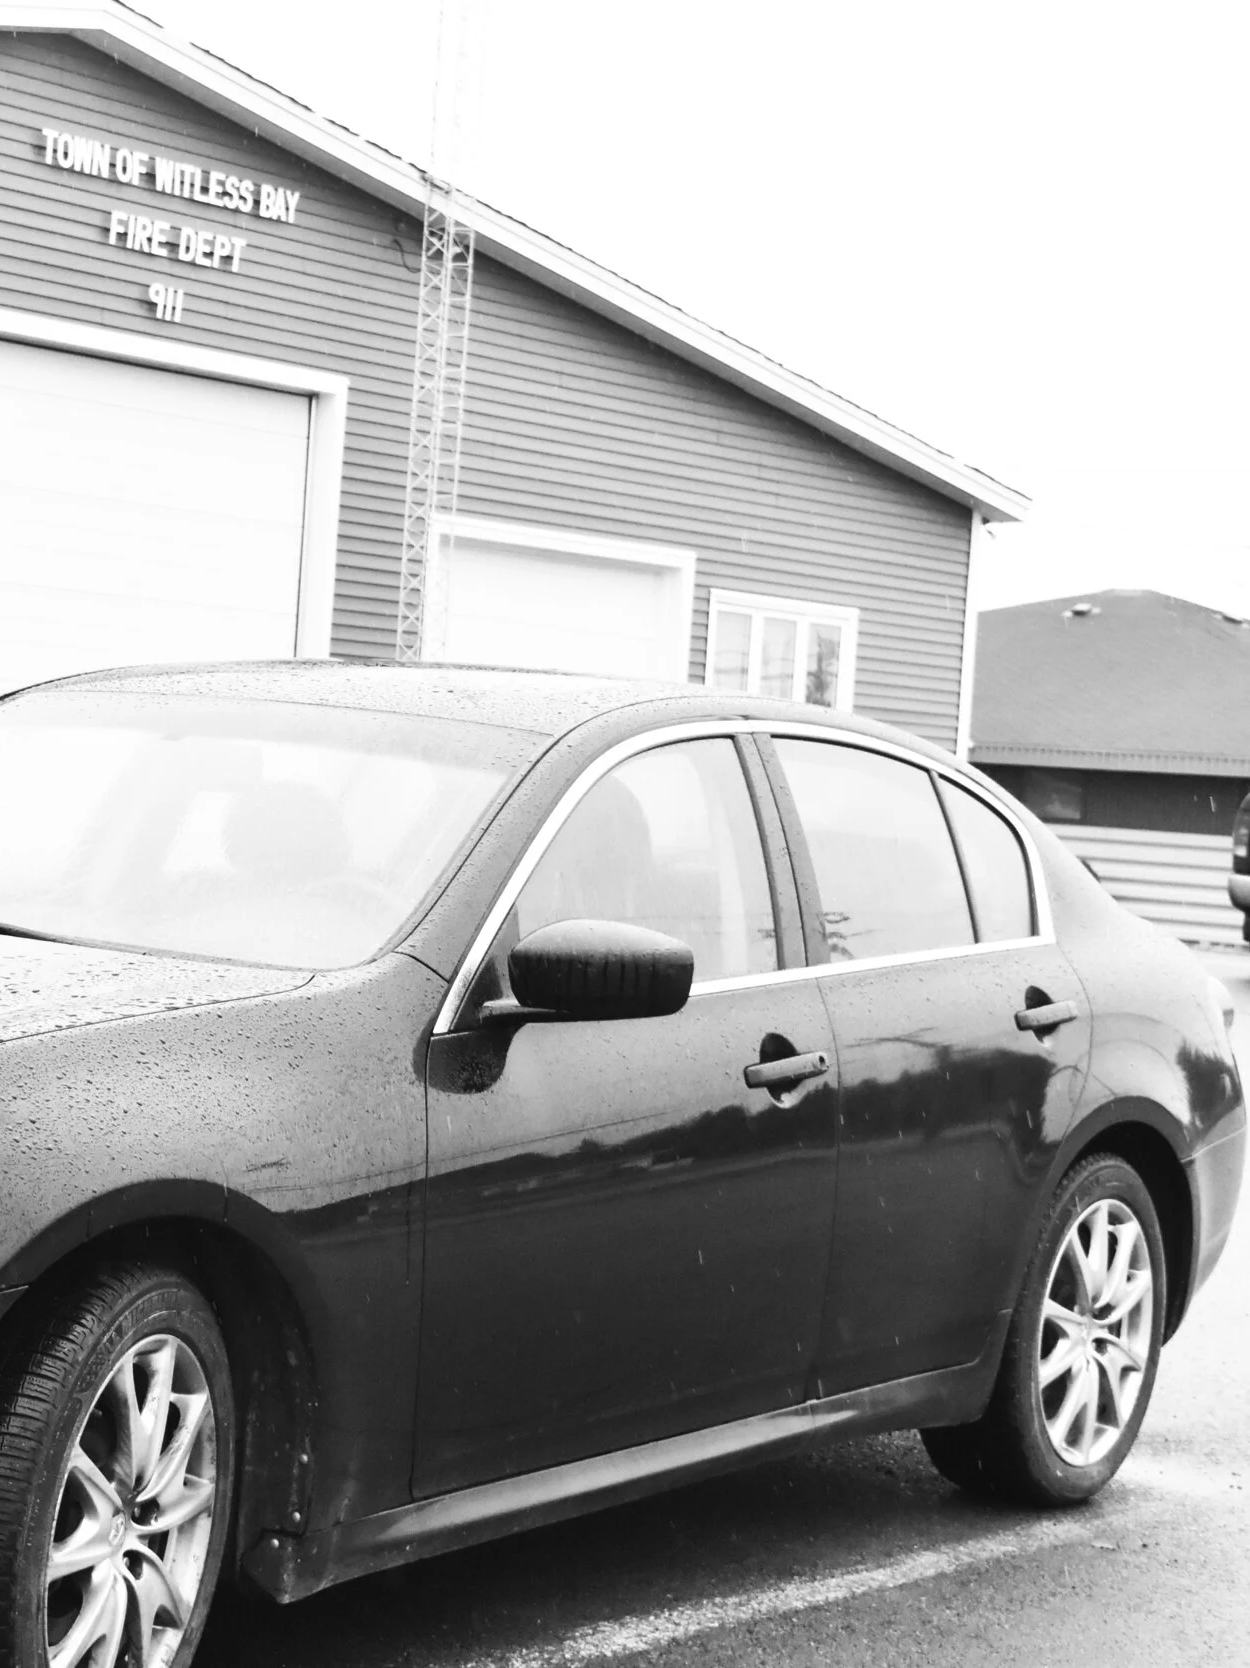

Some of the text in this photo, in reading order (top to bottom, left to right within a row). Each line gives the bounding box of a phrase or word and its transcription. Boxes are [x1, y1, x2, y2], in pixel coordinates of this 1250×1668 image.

[42, 128, 300, 223] TOWN OF WITLESS BAY
[109, 210, 247, 272] FIRE DEPT
[148, 282, 184, 323] 911
